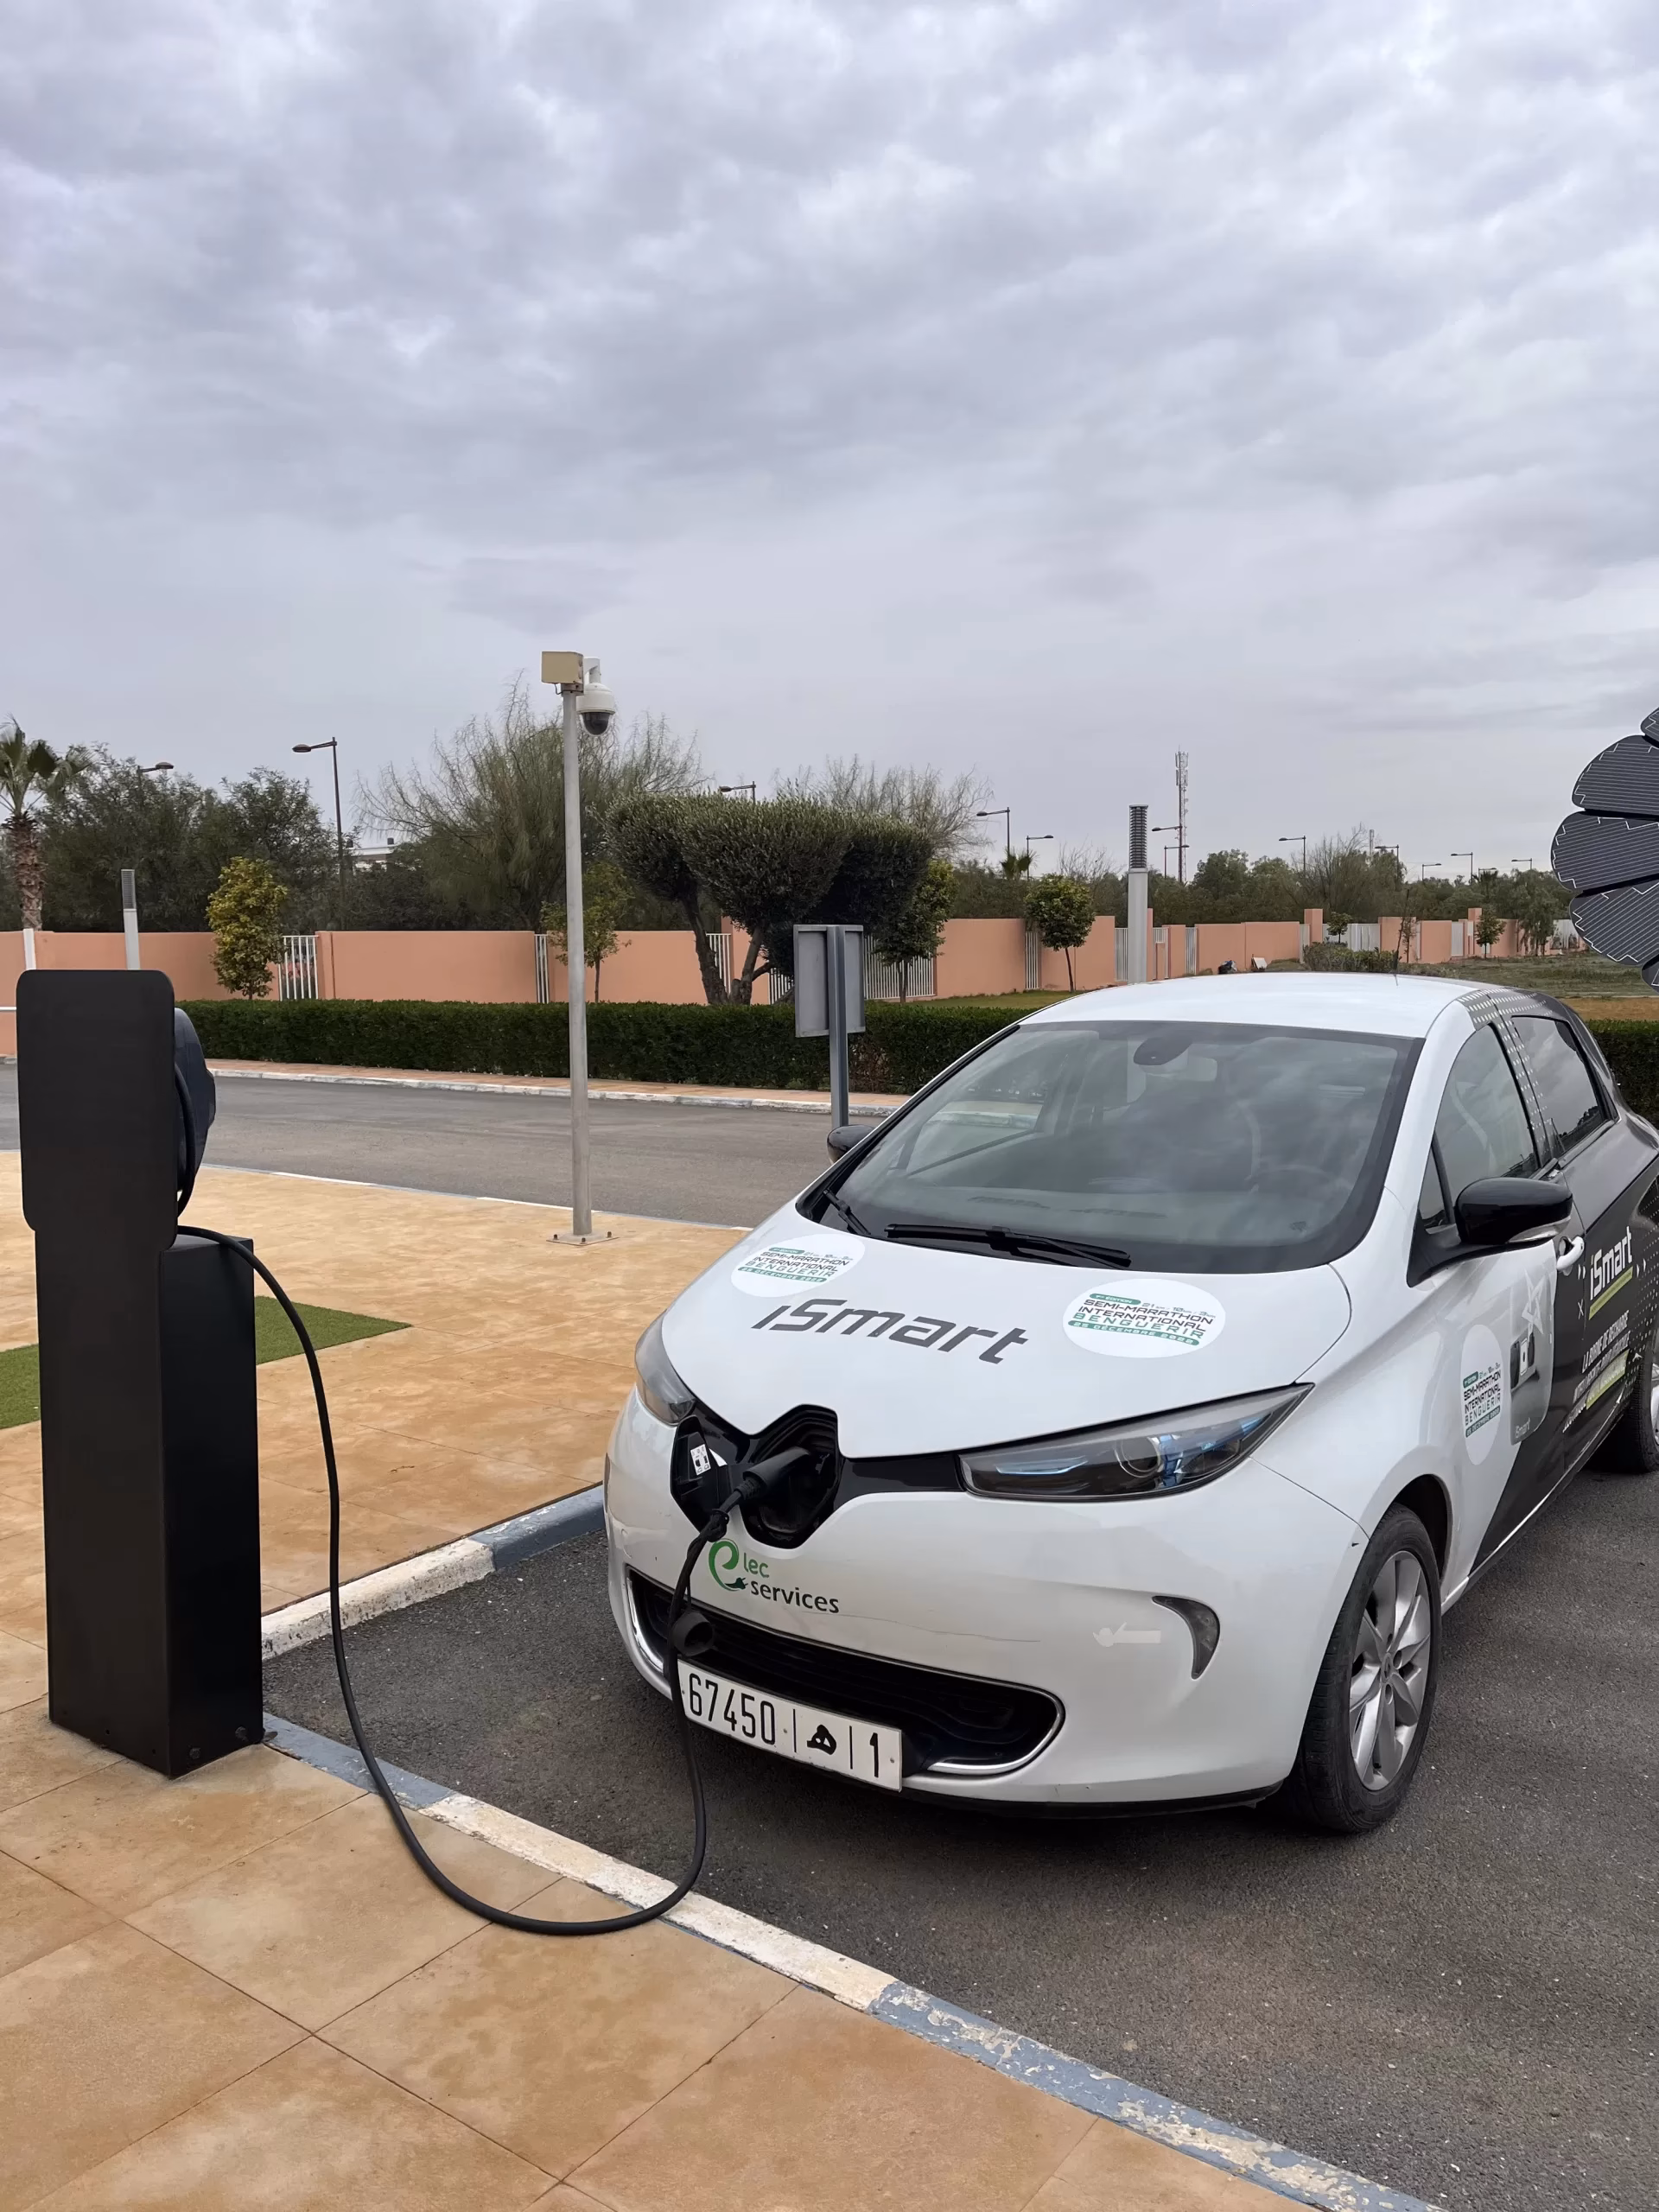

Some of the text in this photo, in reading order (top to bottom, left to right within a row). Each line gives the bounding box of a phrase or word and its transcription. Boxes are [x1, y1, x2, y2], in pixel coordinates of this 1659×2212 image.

[745, 1261, 836, 1277] BENGUERIR
[753, 1256, 838, 1271] INTERNATIONAL
[760, 1251, 850, 1266] SEMI-MARATHON
[1590, 1226, 1632, 1300] iSmart
[1072, 1313, 1205, 1339] BENGUERIR
[1077, 1306, 1207, 1332] INTERNATIONAL
[1084, 1299, 1213, 1325] SEMI-MARATHON
[751, 1298, 1029, 1365] iSmart
[1464, 1369, 1502, 1402] SEMI-MARATHON
[1465, 1383, 1501, 1414] INTERNATIONAL
[1465, 1392, 1501, 1427] BENGUERIR
[750, 1579, 840, 1614] services
[689, 1673, 777, 1745] 67450
[869, 1732, 880, 1778] 1
